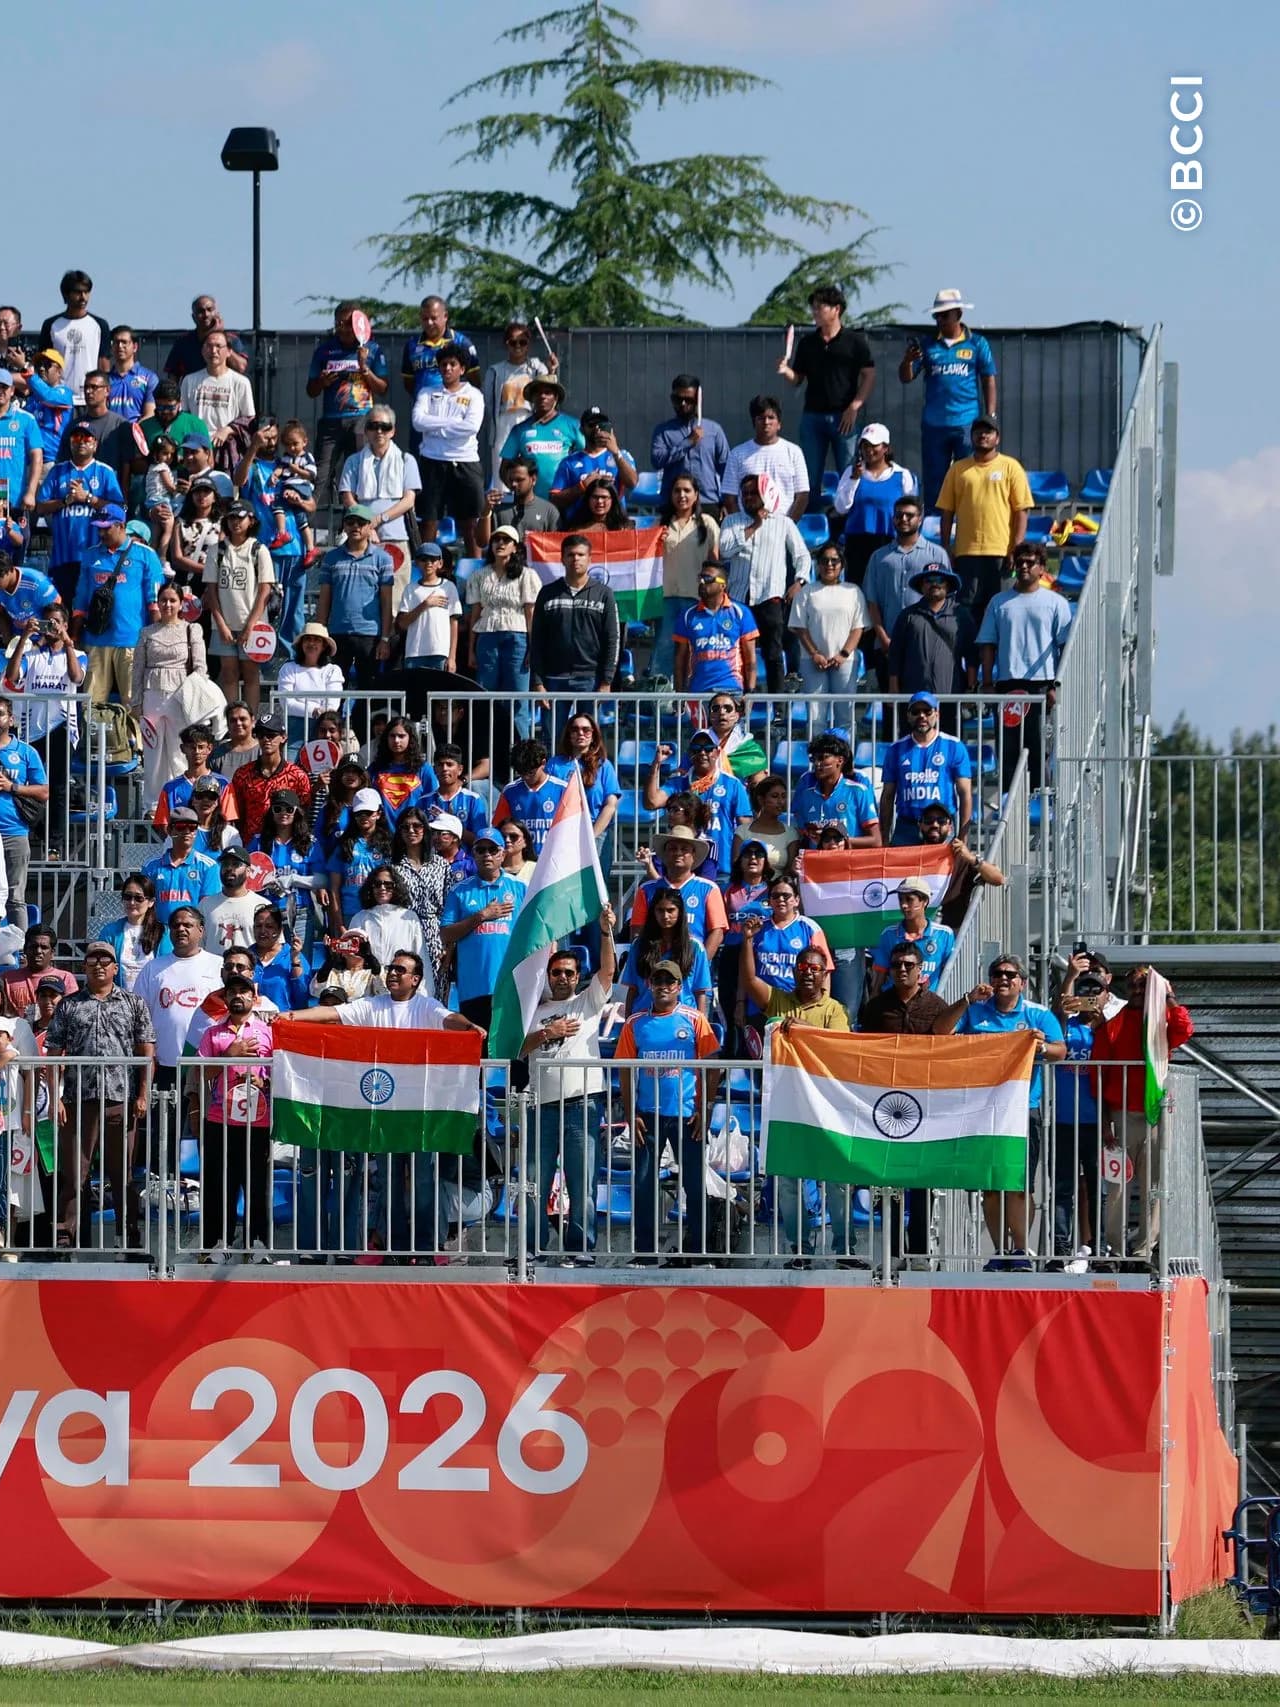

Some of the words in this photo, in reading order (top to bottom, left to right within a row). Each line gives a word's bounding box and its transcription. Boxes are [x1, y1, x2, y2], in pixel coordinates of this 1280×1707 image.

[943, 362, 969, 377] LANKA
[220, 566, 247, 590] 82
[312, 744, 326, 762] 6
[904, 767, 940, 781] apollo
[902, 785, 941, 801] INDIA
[159, 889, 193, 903] INDIA
[759, 964, 795, 981] INDIA
[188, 1365, 589, 1495] 2026
